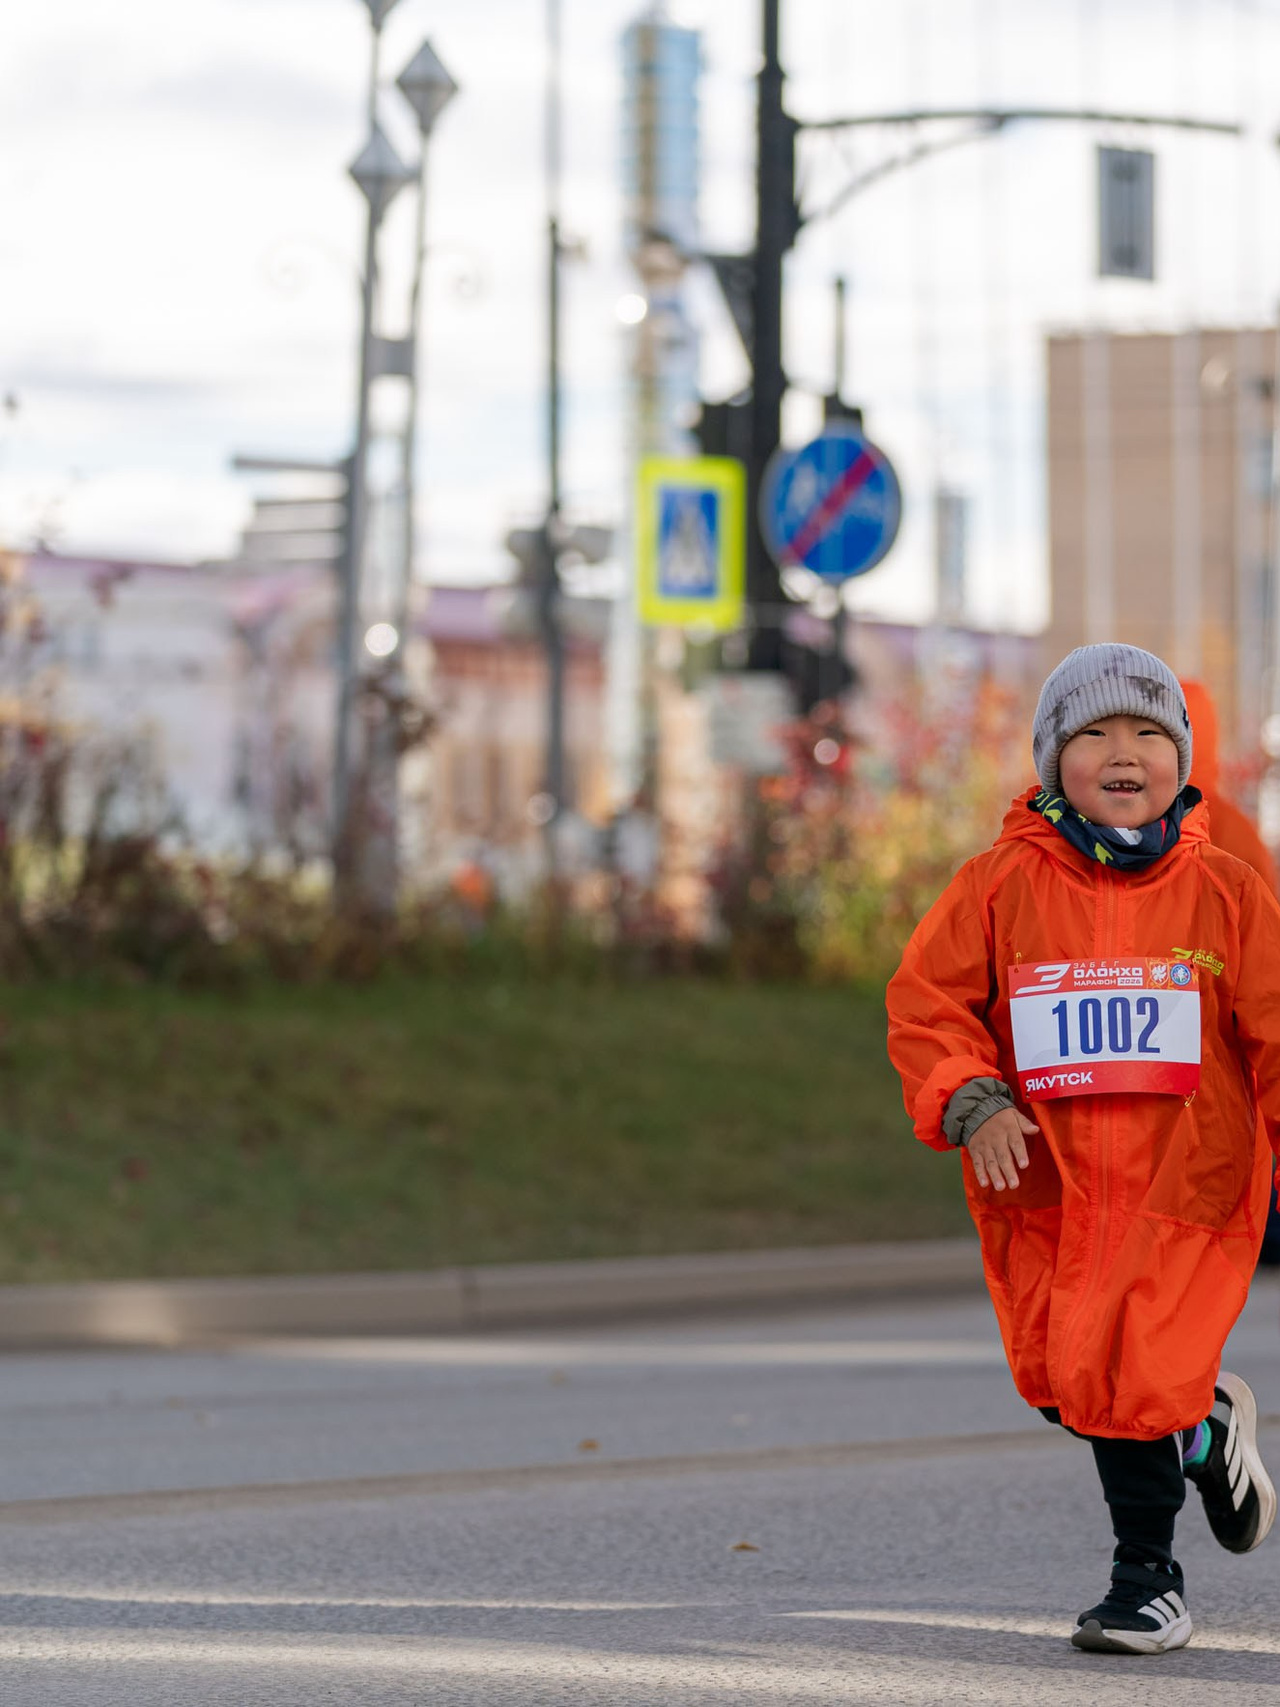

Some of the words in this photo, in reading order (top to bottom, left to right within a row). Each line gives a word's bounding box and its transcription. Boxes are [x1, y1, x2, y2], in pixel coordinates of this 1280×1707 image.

[1073, 960, 1120, 969] ЗАБЕГ
[1073, 967, 1143, 979] ОЛОНХО
[1073, 979, 1117, 987] МАРАФОН
[1052, 996, 1161, 1057] 1002
[1025, 1071, 1093, 1092] ЯКУТСК
